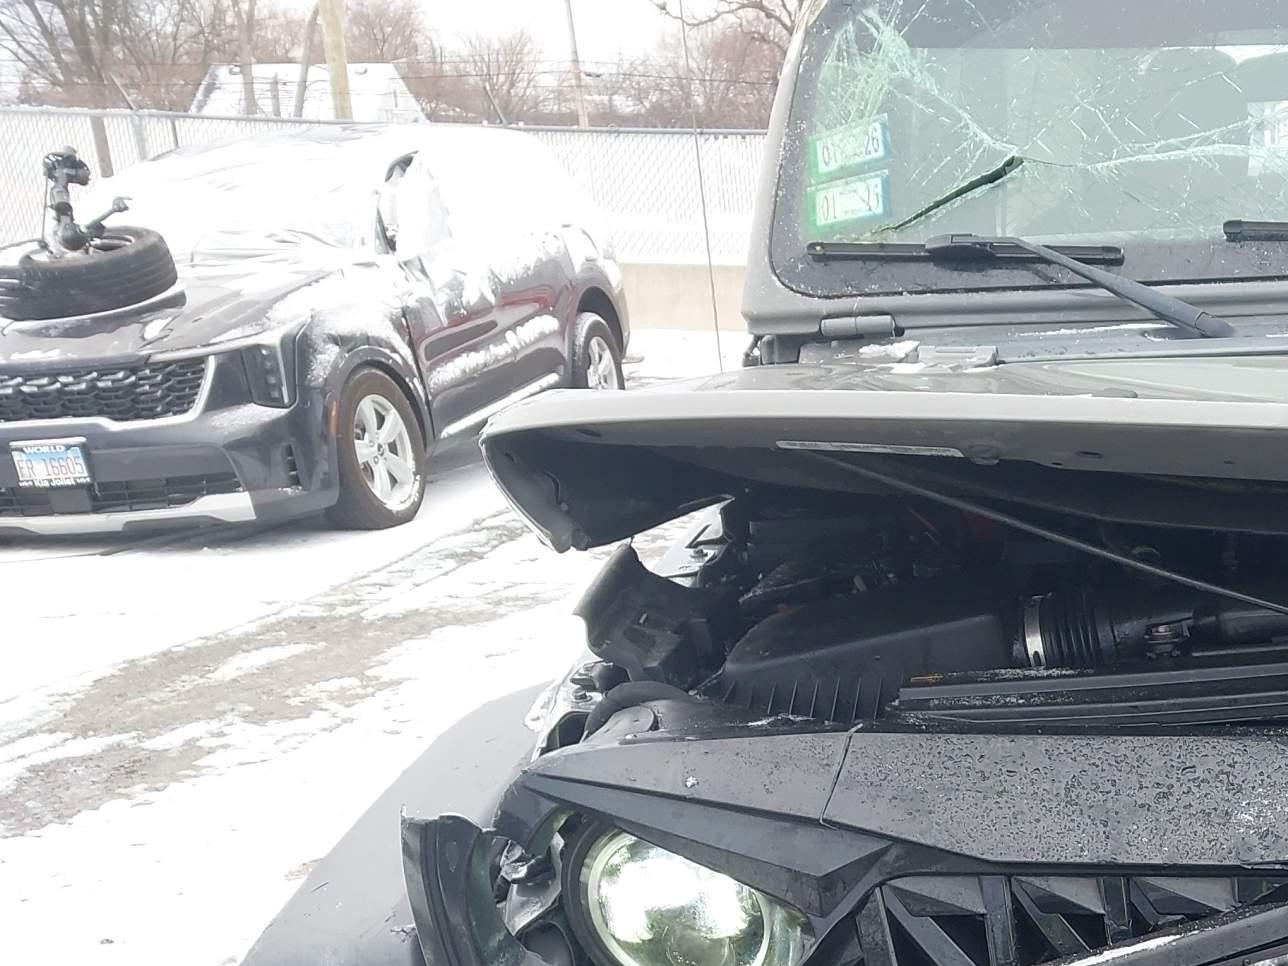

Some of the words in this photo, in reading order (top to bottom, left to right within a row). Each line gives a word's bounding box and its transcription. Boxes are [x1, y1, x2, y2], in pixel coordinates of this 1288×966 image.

[23, 445, 66, 454] WORLD
[42, 456, 85, 477] 16605
[33, 479, 50, 487] Kia
